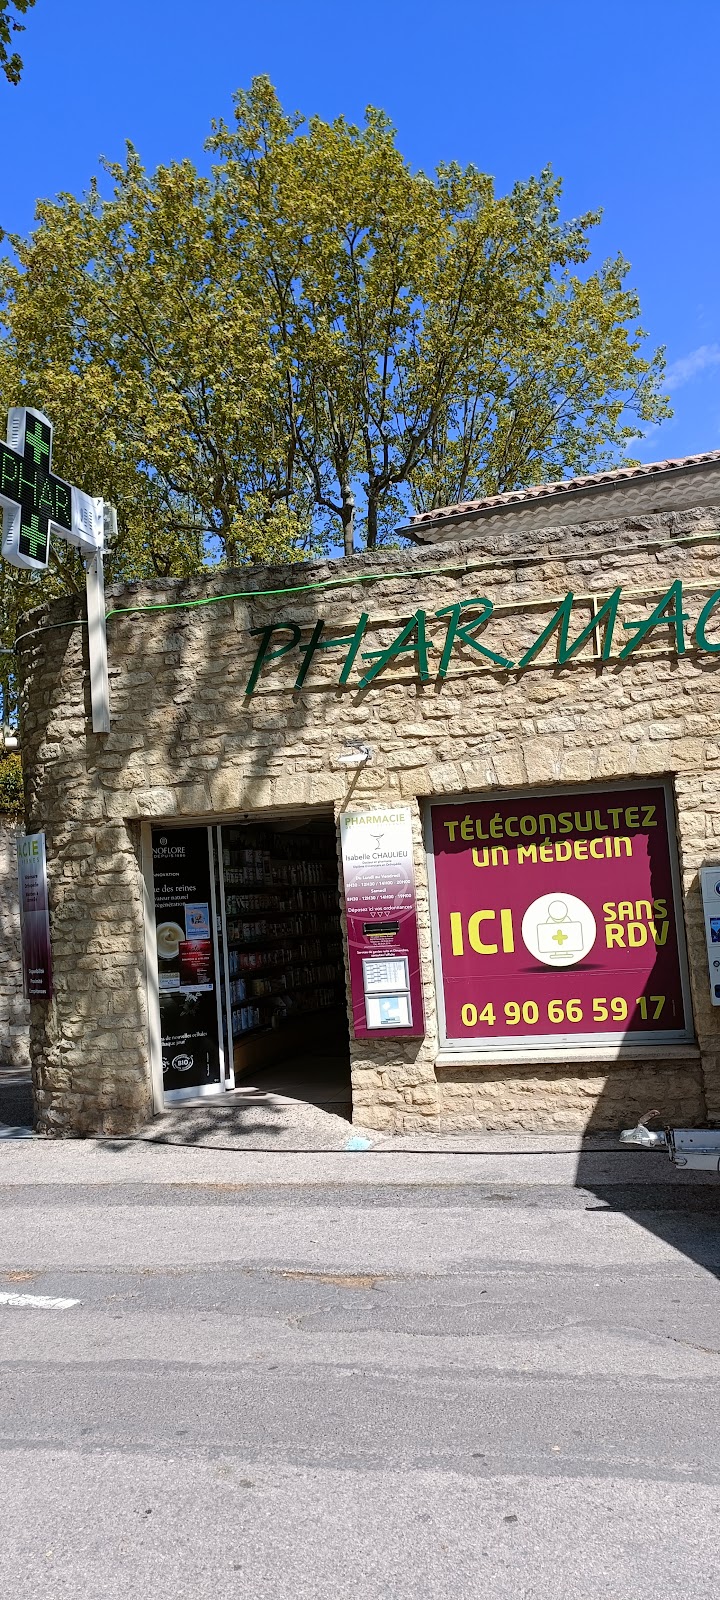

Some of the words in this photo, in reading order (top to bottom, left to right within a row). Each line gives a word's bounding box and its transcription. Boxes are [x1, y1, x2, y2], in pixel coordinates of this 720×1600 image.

[1, 452, 71, 525] PHAR
[344, 813, 405, 826] PHARMACIE
[443, 805, 658, 842] TÉLÉCONSULTEZ
[345, 853, 371, 861] Isabelle
[371, 850, 408, 860] CHAULIEU
[517, 836, 633, 865] MÉDECIN
[161, 884, 174, 892] des
[175, 884, 197, 892] reines
[449, 908, 515, 956] ICI
[602, 899, 668, 922] SANS
[605, 921, 670, 949] RDV
[460, 1002, 497, 1027] 04
[503, 1000, 540, 1025] 90
[547, 998, 584, 1024] 66
[592, 996, 629, 1022] 59
[635, 995, 666, 1020] 17
